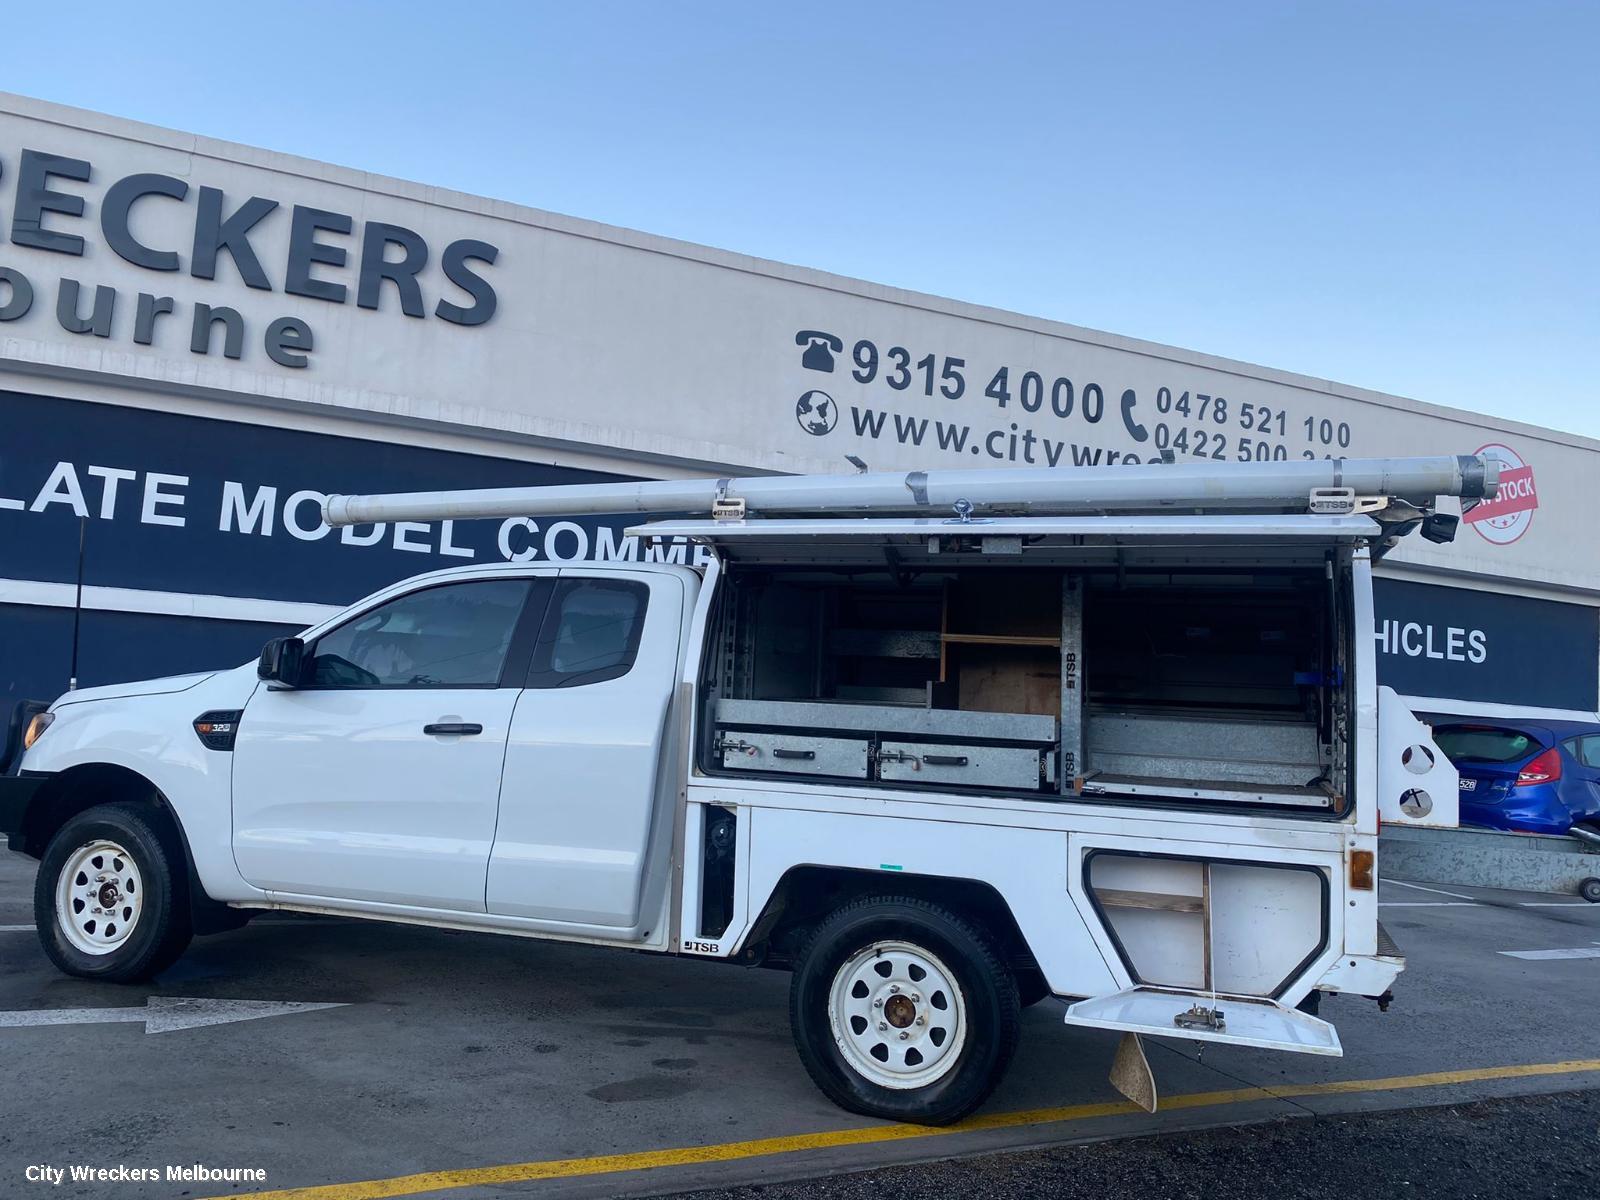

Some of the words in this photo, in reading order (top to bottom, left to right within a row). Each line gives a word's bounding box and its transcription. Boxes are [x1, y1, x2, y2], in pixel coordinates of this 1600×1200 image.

[0, 148, 501, 327] ECKERS
[851, 339, 966, 400] 9315
[985, 366, 1104, 424] 4000
[850, 406, 1163, 467] www.citywr
[1156, 386, 1228, 425] 0478
[1239, 402, 1287, 437] 521
[1304, 416, 1350, 448] 100
[1154, 423, 1227, 461] 0422
[1066, 652, 1076, 679] TSB
[1065, 752, 1075, 779] TSB
[693, 941, 720, 953] TSB
